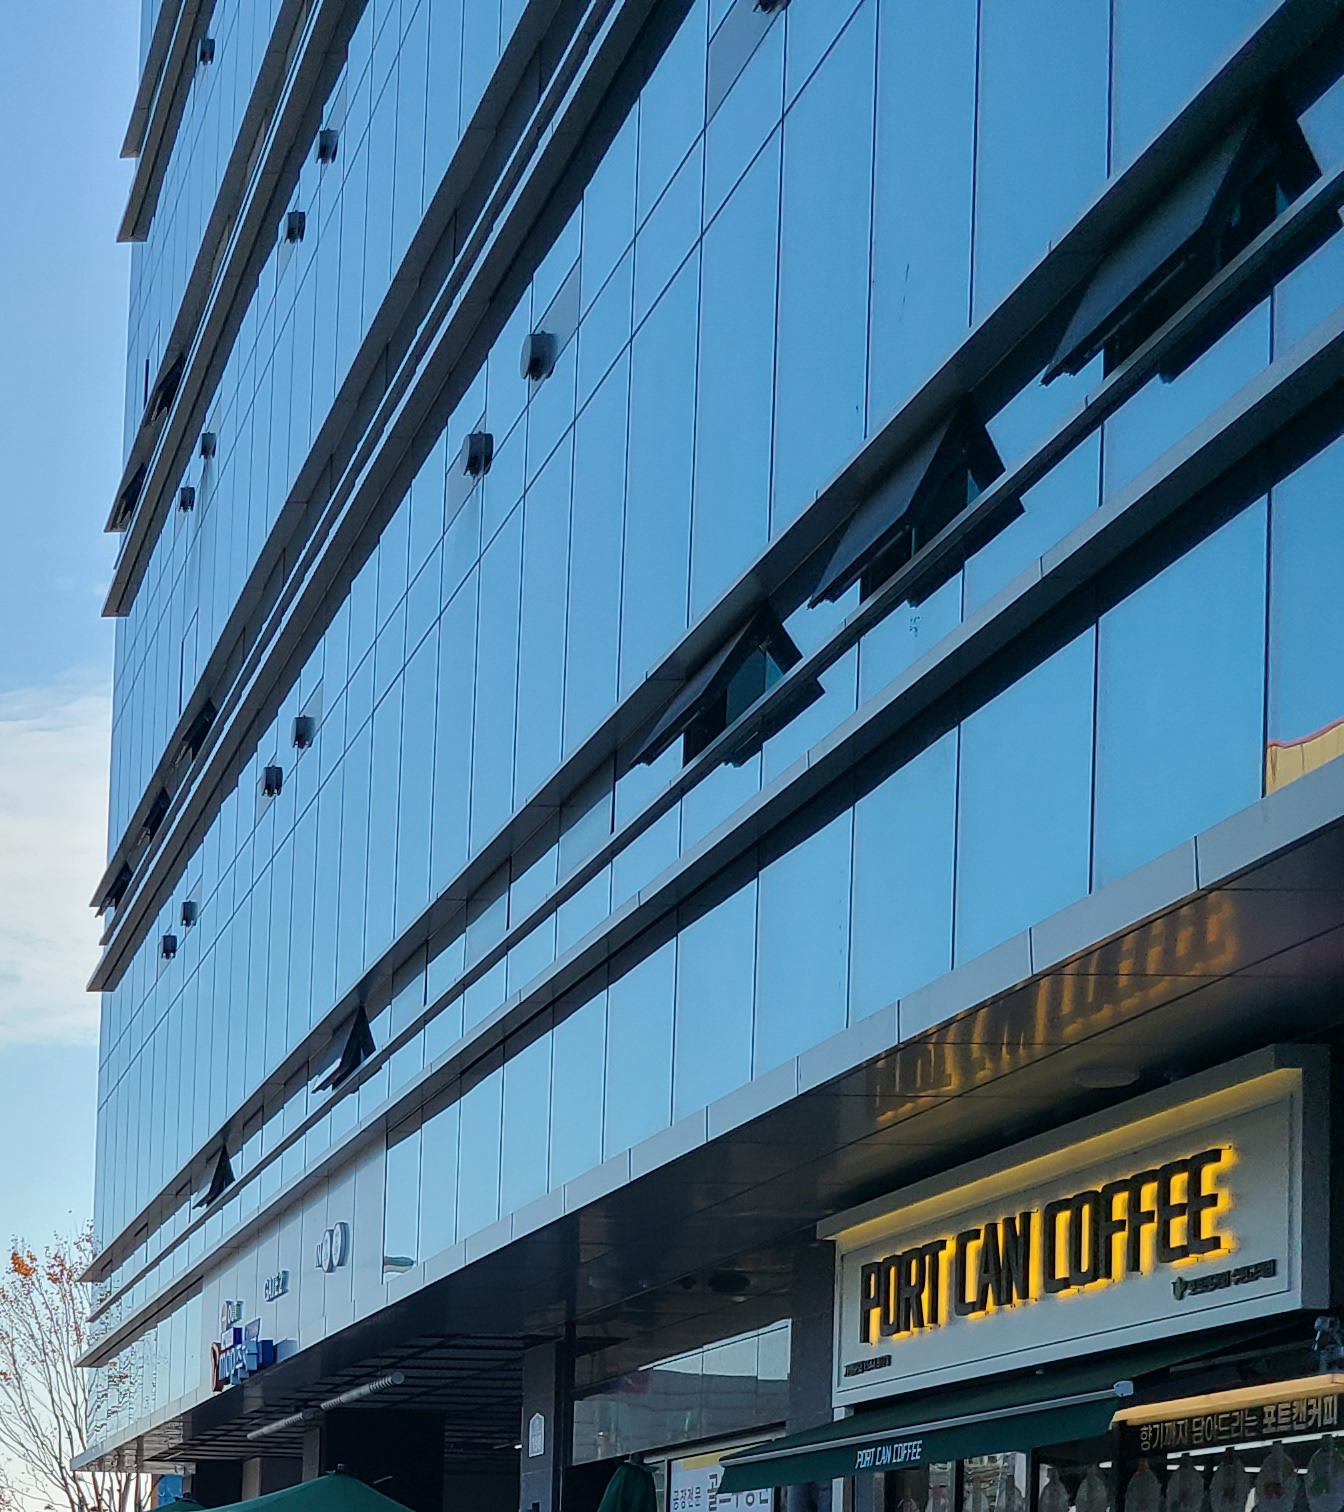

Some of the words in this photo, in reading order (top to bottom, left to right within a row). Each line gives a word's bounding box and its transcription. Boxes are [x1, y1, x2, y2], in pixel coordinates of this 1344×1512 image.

[859, 1239, 947, 1344] PORT
[955, 1211, 1032, 1316] CAN
[1044, 1148, 1224, 1294] COFFEE
[1140, 1418, 1189, 1452] 향기까지
[1191, 1409, 1258, 1445] 담아드리는
[1262, 1394, 1339, 1434] 포트캔커피
[855, 1447, 876, 1469] PORT
[876, 1445, 892, 1465] CAN
[892, 1440, 923, 1463] COFFEE
[672, 1486, 701, 1511] 공장전문
